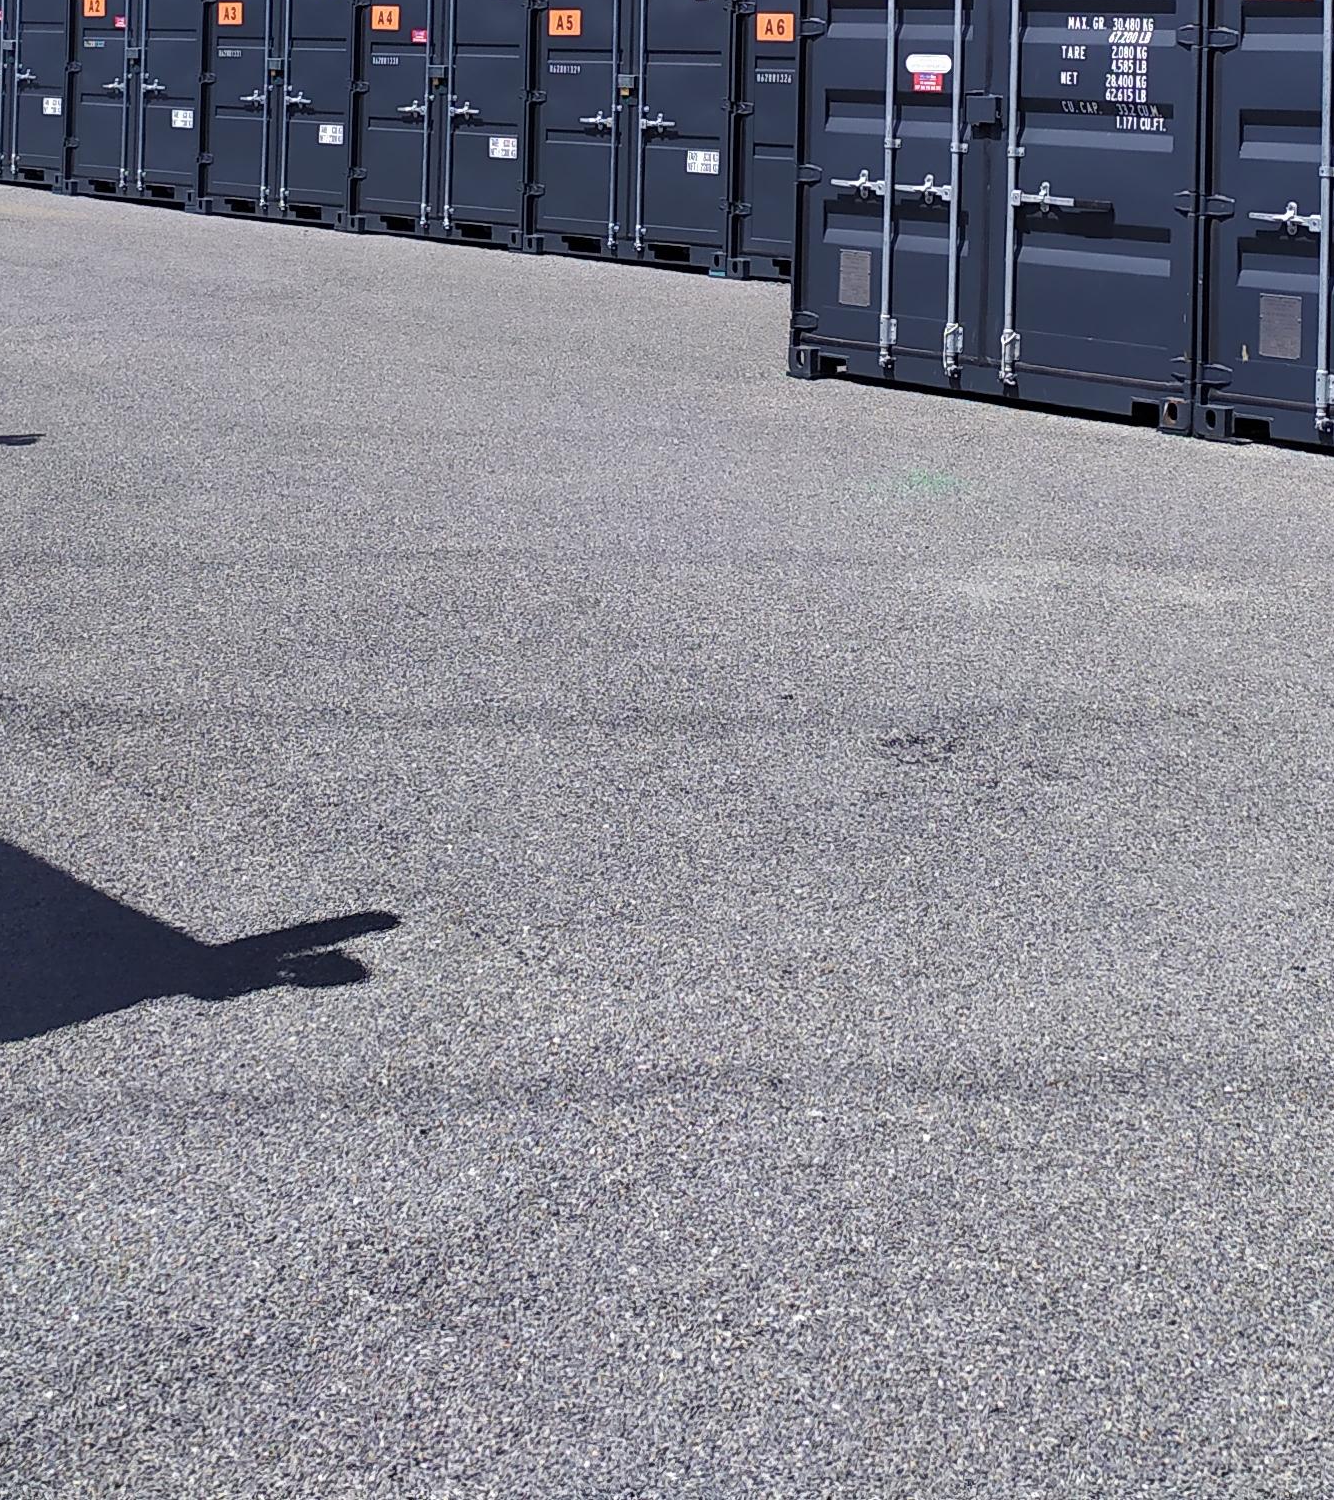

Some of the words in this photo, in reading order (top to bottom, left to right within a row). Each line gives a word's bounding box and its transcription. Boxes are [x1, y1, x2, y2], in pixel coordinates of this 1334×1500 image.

[1067, 16, 1090, 30] MAX.
[1092, 16, 1107, 30] GR.
[1142, 18, 1154, 32] KG
[1138, 32, 1152, 44] LB
[1061, 45, 1086, 59] TARE
[1136, 46, 1148, 60] KG
[1136, 60, 1147, 74] LB
[1060, 71, 1078, 85] NET
[1135, 75, 1147, 89] KG
[1135, 89, 1147, 103] LB
